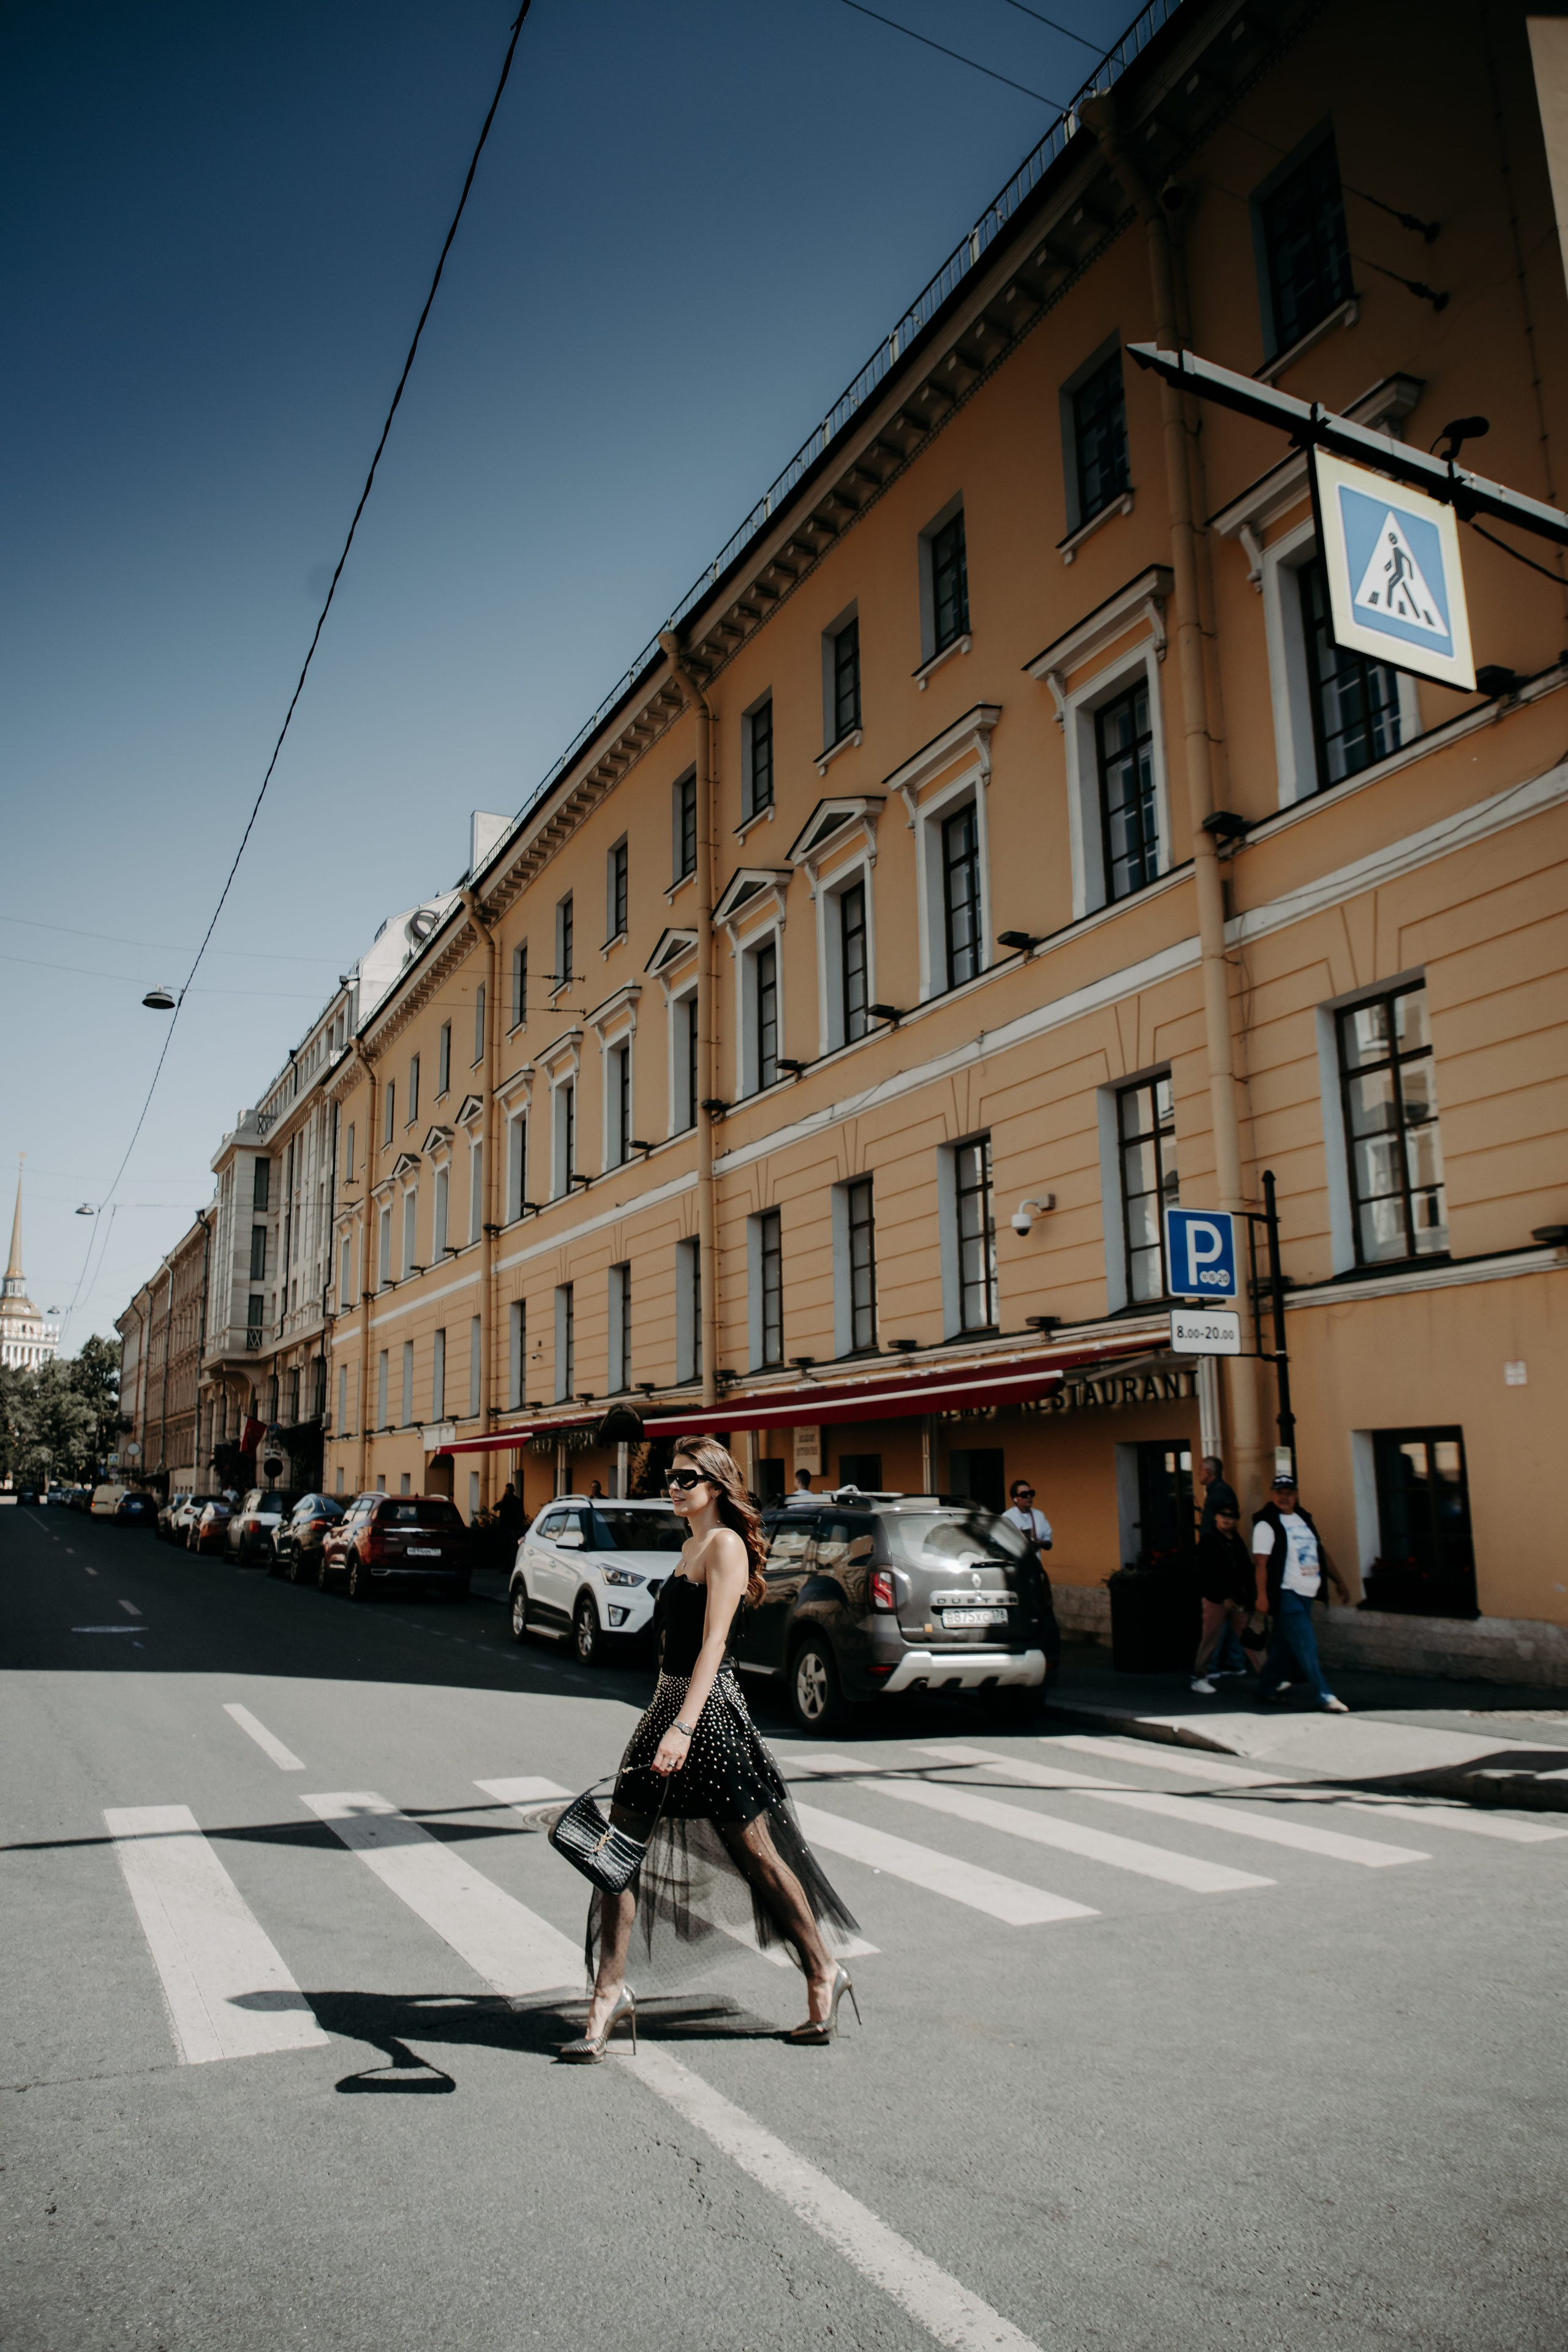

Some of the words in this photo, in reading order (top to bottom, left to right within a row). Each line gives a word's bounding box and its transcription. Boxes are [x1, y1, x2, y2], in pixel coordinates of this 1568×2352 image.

[1186, 1219, 1223, 1286] P
[1218, 1273, 1229, 1283] 20
[1177, 1325, 1235, 1340] 8.00-20.00
